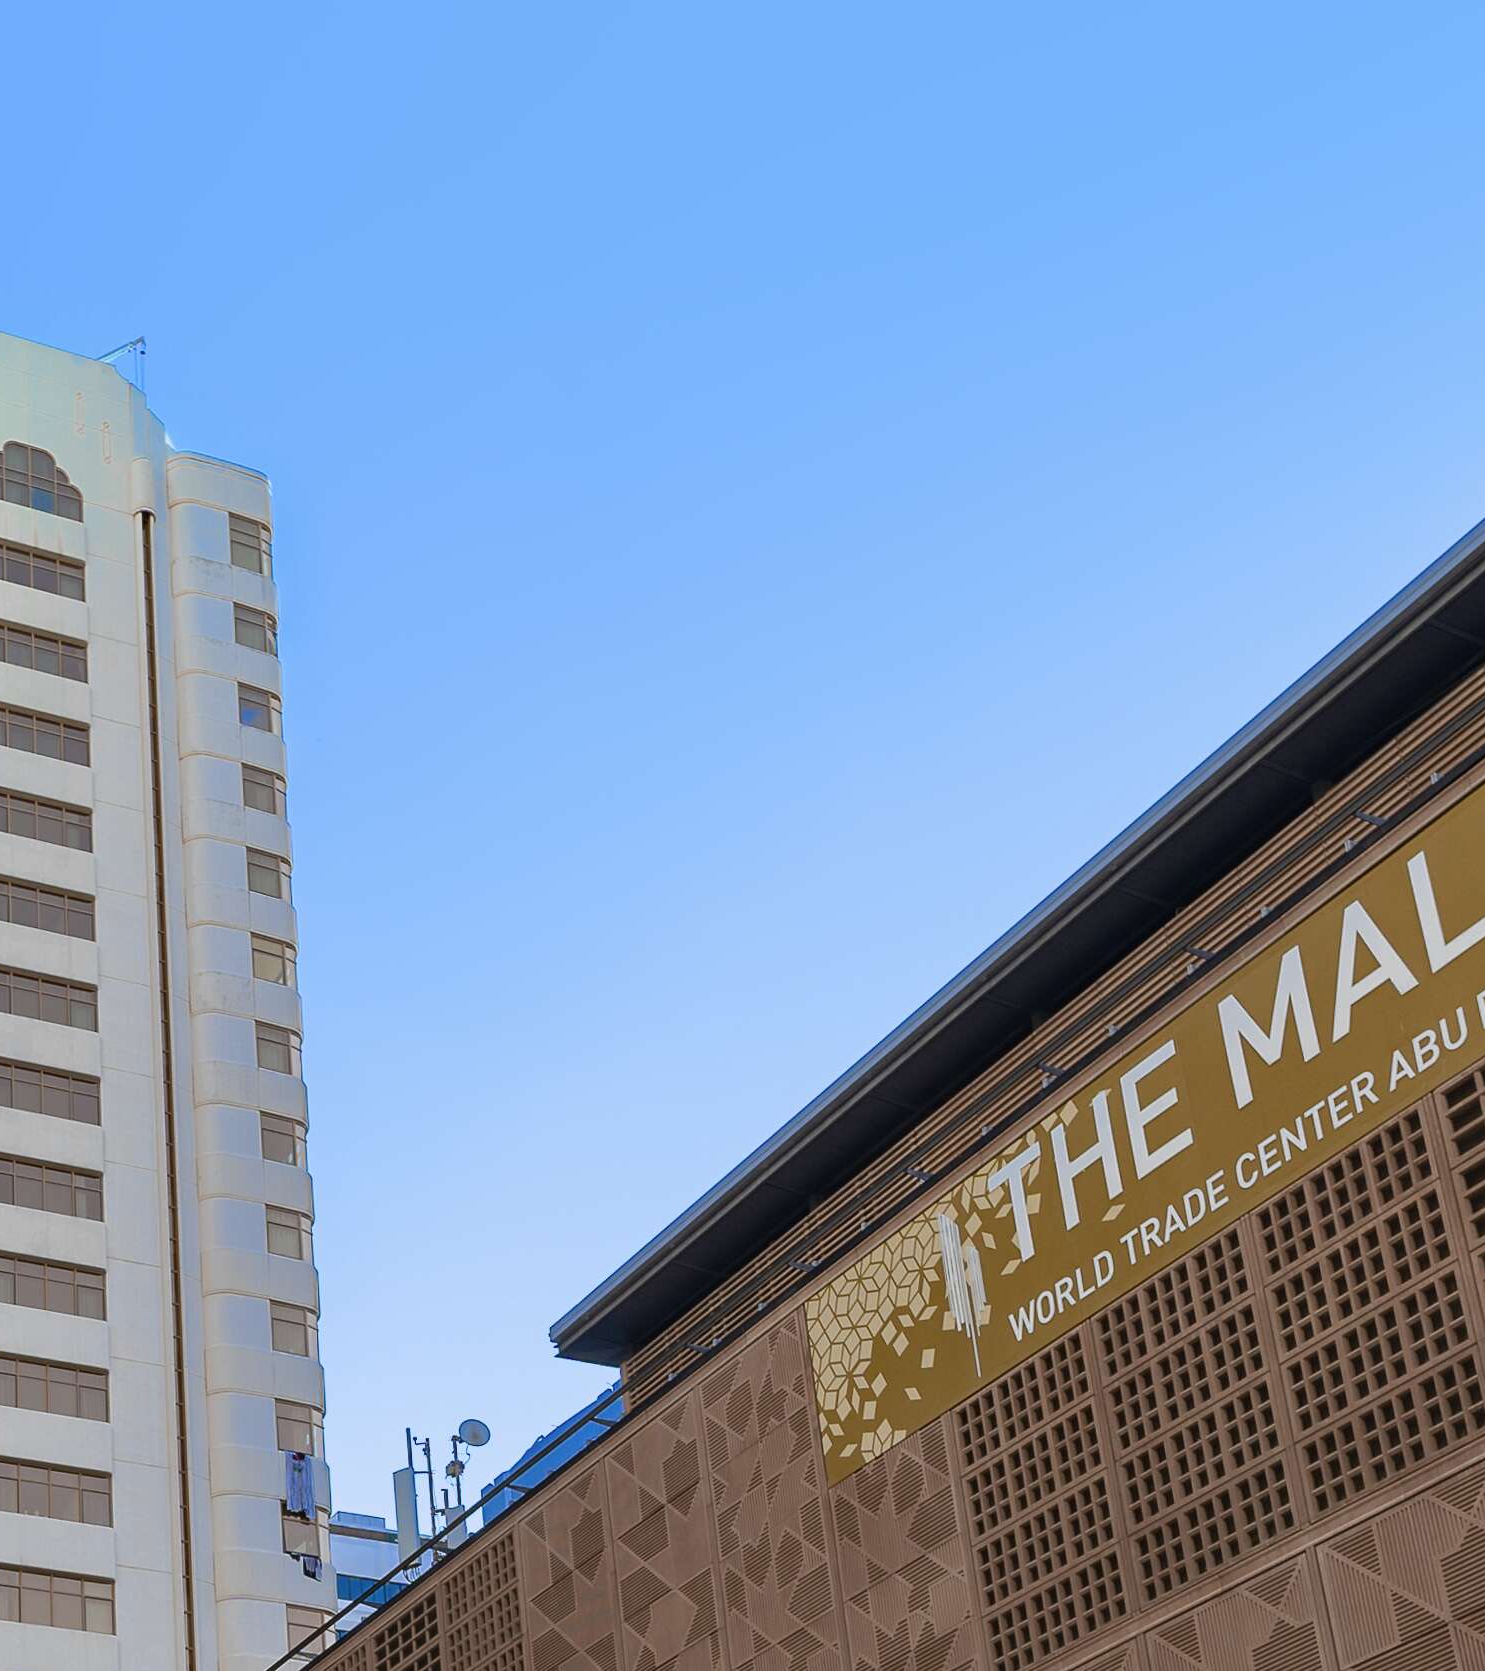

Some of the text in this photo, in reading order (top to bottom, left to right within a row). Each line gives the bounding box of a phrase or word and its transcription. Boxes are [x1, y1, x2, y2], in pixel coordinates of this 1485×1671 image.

[987, 1039, 1195, 1262] THE
[1008, 1250, 1114, 1342] WORLD
[1119, 1169, 1229, 1265] TRADE
[1235, 1071, 1379, 1189] CENTER
[1389, 1006, 1468, 1092] ABU
